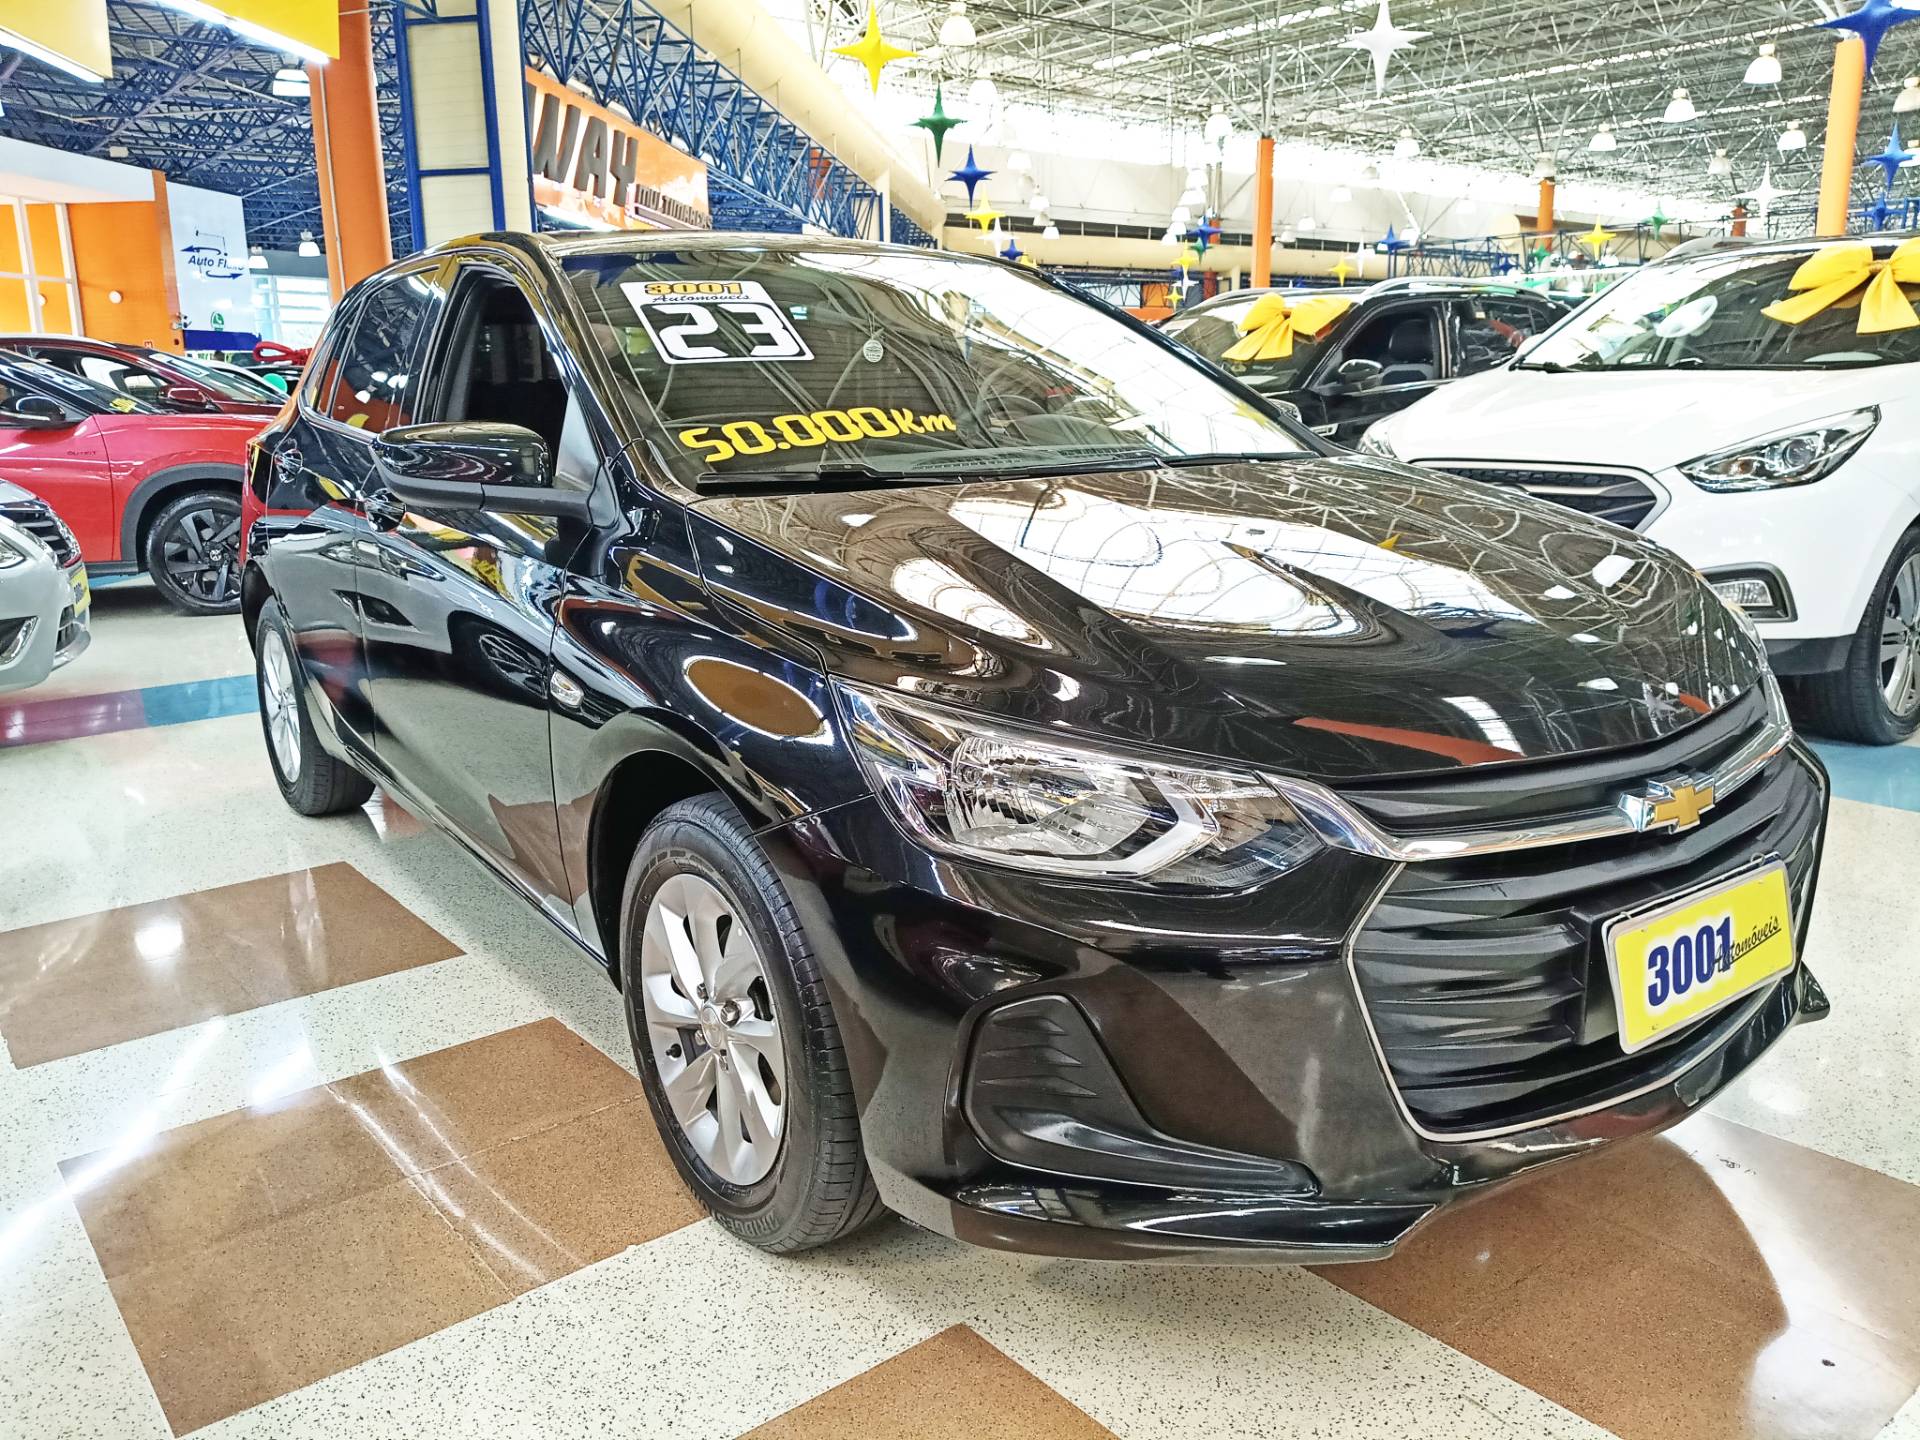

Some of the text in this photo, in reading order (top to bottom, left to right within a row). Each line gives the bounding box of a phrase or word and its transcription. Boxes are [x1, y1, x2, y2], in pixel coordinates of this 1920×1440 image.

[188, 255, 214, 267] Auto
[645, 282, 743, 296] 3001
[651, 303, 801, 359] 23
[1648, 916, 1731, 1007] 3001
